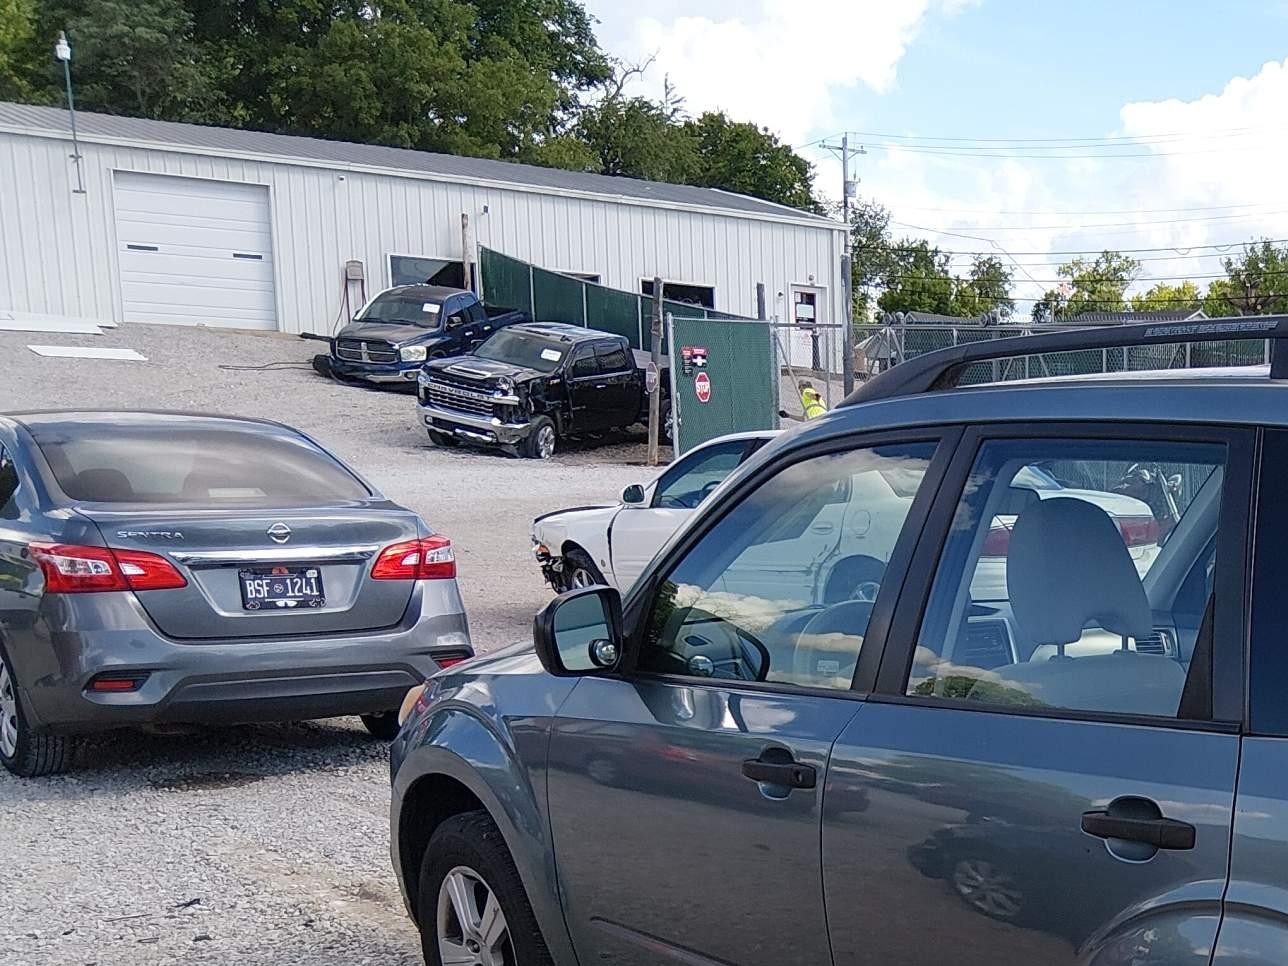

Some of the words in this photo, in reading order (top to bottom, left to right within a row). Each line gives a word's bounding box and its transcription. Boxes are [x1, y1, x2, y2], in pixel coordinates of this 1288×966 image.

[117, 530, 185, 540] SENTRA
[245, 579, 271, 599] BSF
[286, 578, 320, 597] 1241
